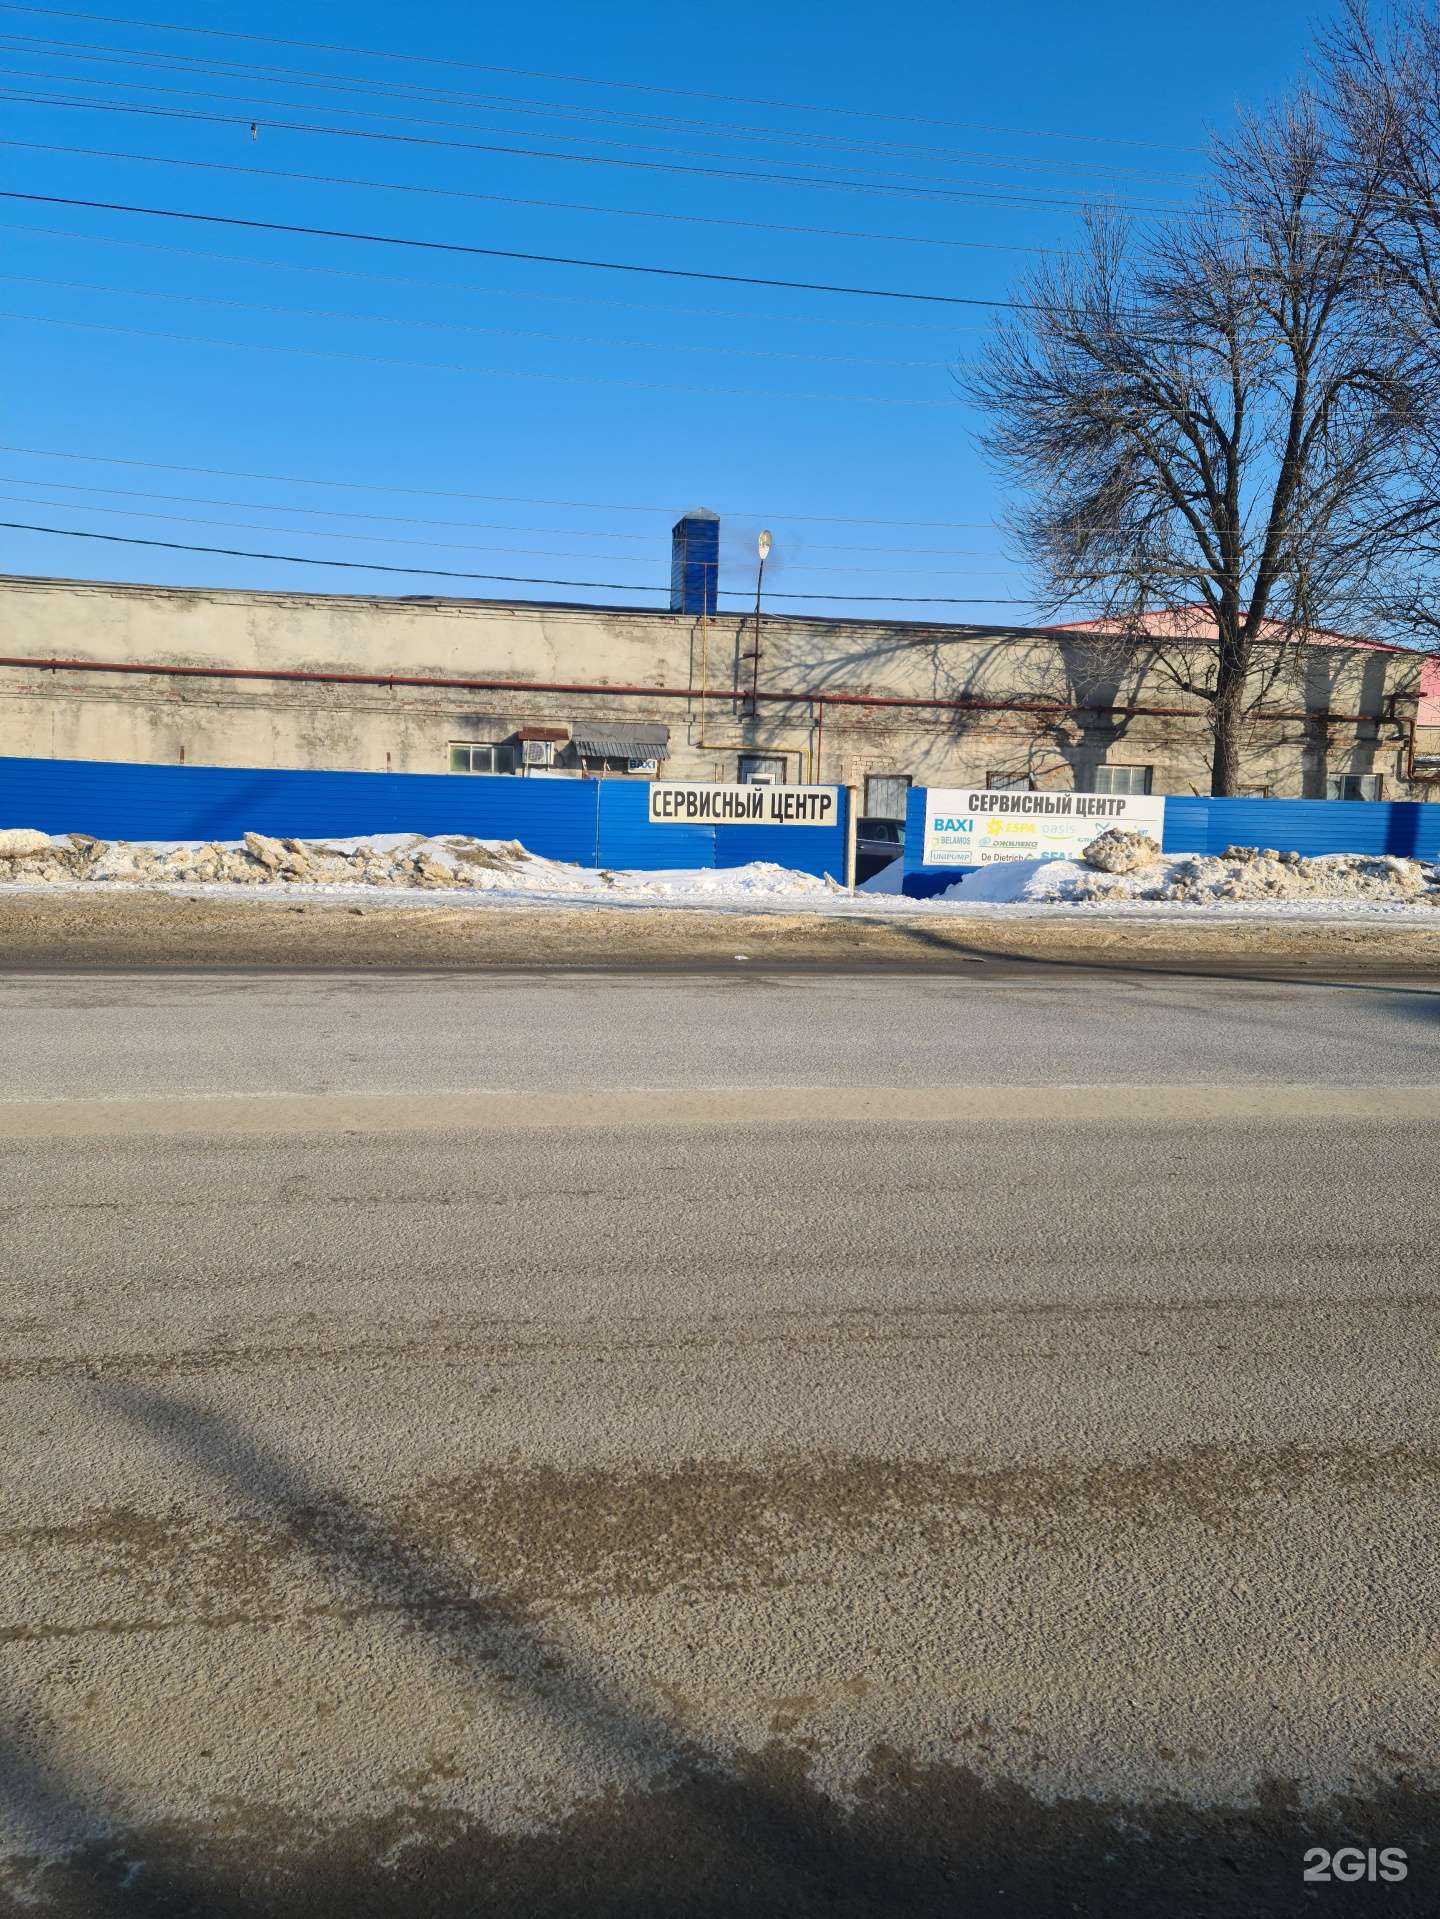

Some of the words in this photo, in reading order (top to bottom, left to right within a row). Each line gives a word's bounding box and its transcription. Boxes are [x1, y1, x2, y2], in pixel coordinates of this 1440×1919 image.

[629, 760, 656, 769] BAXI
[652, 787, 764, 819] СЕРВИСНЫЙ
[770, 793, 832, 823] ЦЕНТР
[968, 792, 1073, 815] СЕРВИСНЫЙ
[1075, 797, 1126, 818] ЦЕНТР
[934, 818, 974, 832] BAXI
[1005, 822, 1036, 833] ESPA
[940, 836, 971, 846] BELAMOS
[932, 852, 970, 861] UNIPUMP
[981, 852, 992, 862] De
[993, 853, 1024, 863] Dietrich
